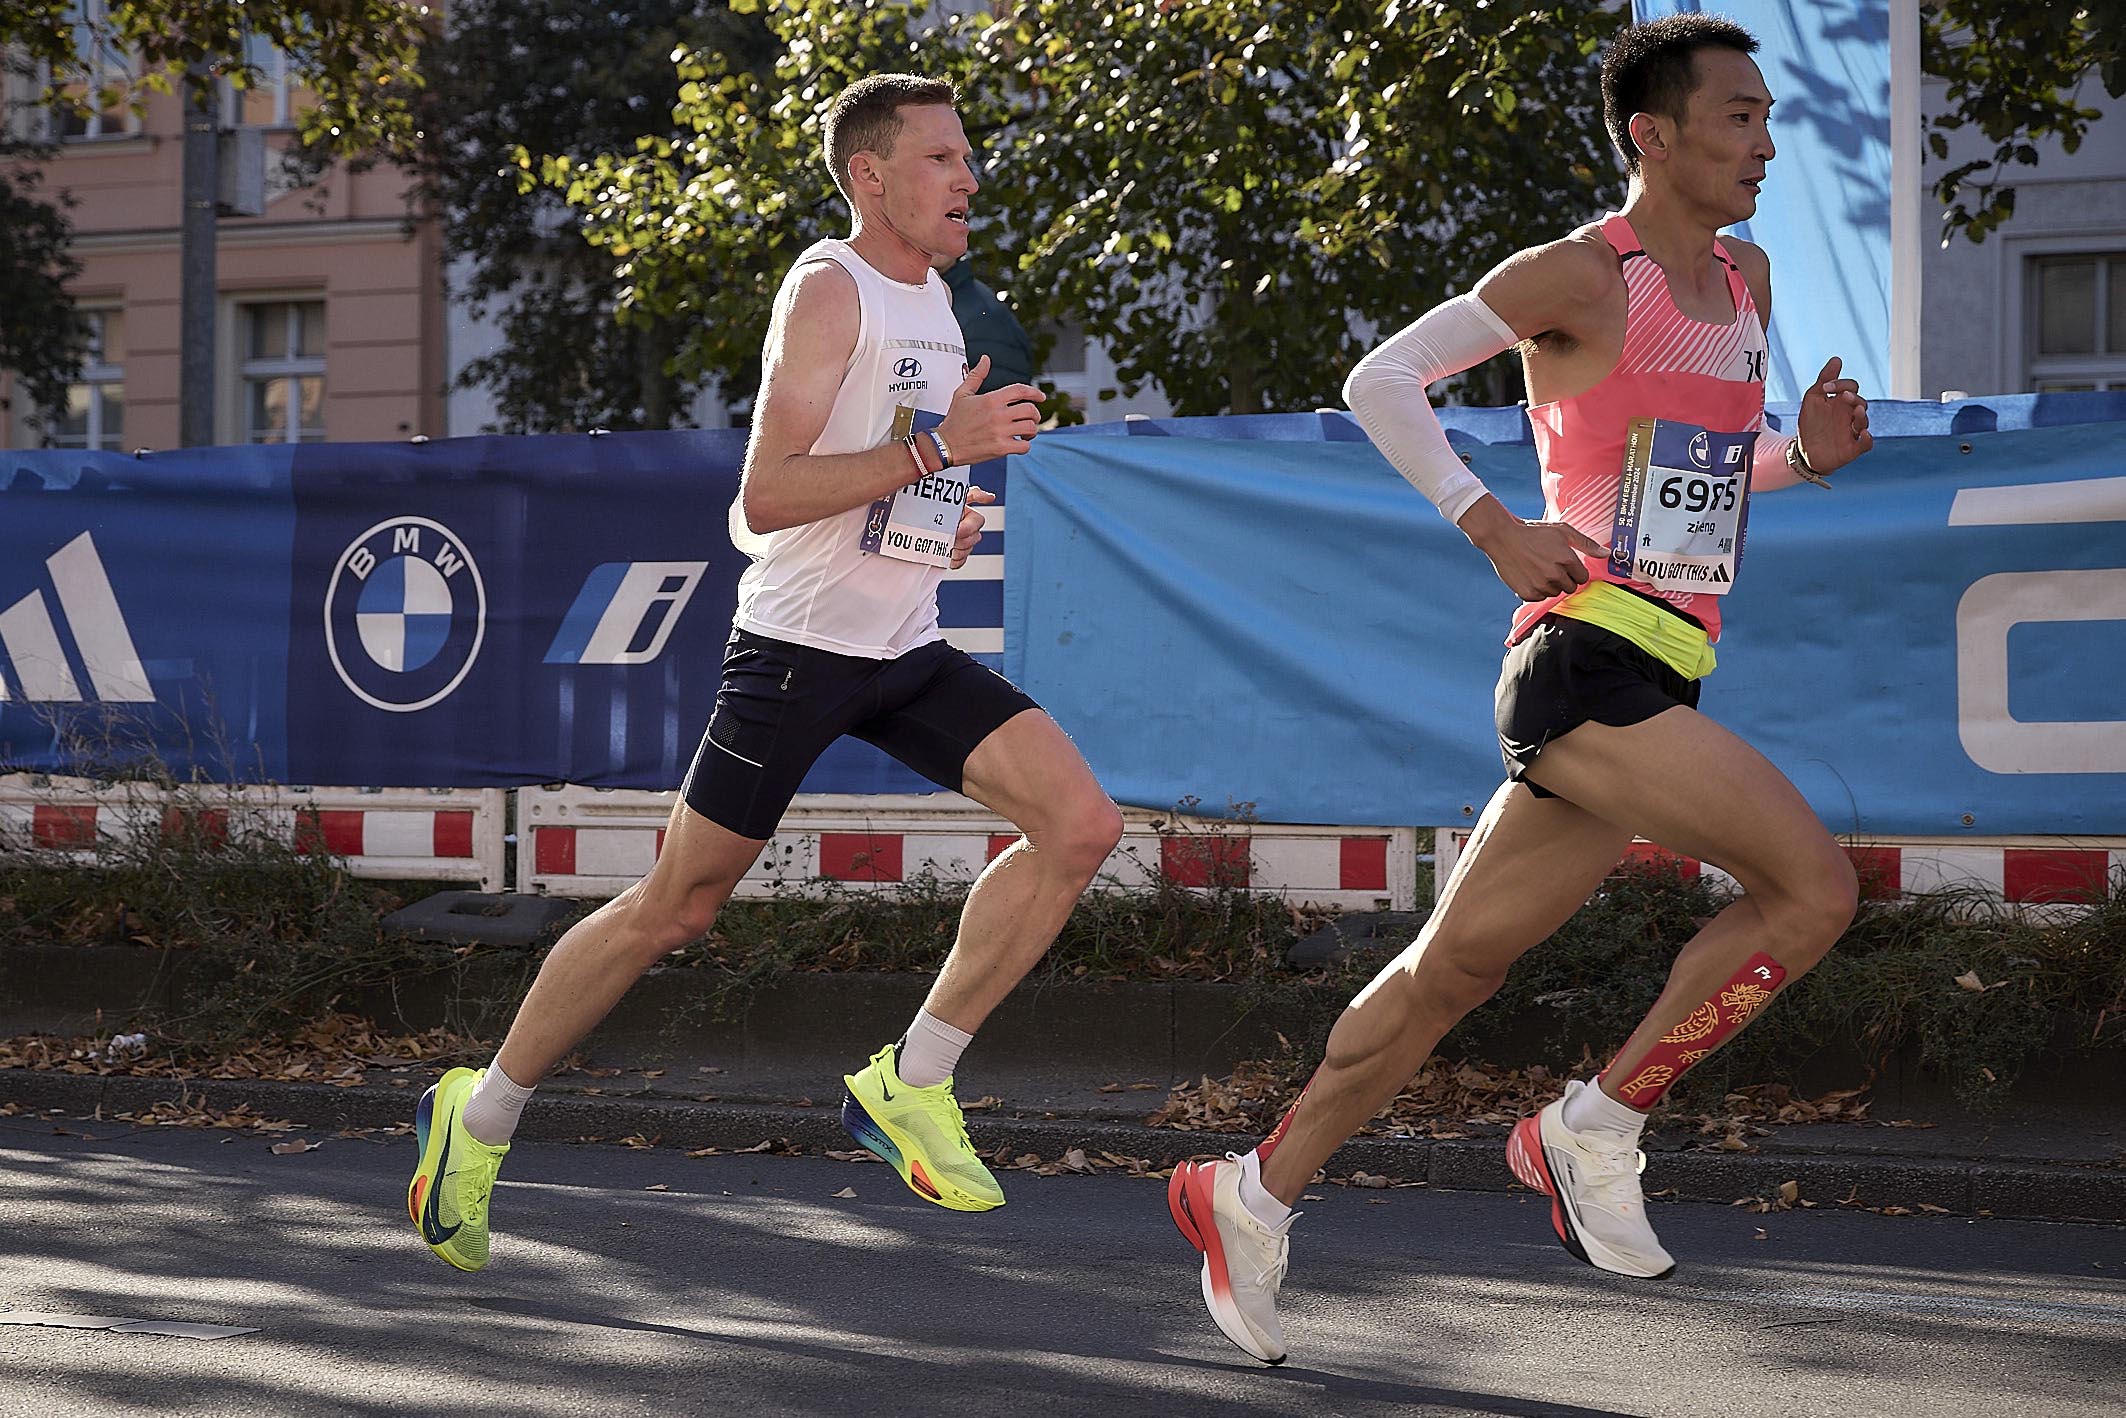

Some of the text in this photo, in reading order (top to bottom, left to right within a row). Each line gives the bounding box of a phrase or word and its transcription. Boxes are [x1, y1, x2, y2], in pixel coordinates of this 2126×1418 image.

[888, 380, 928, 393] HYUNDAI
[1627, 485, 1639, 517] September
[1659, 476, 1738, 513] 6985
[933, 513, 944, 526] 42
[347, 527, 465, 581] BMW
[887, 530, 913, 550] YOU
[914, 537, 934, 554] GOT
[1638, 558, 1710, 581] YOU GOT THIS
